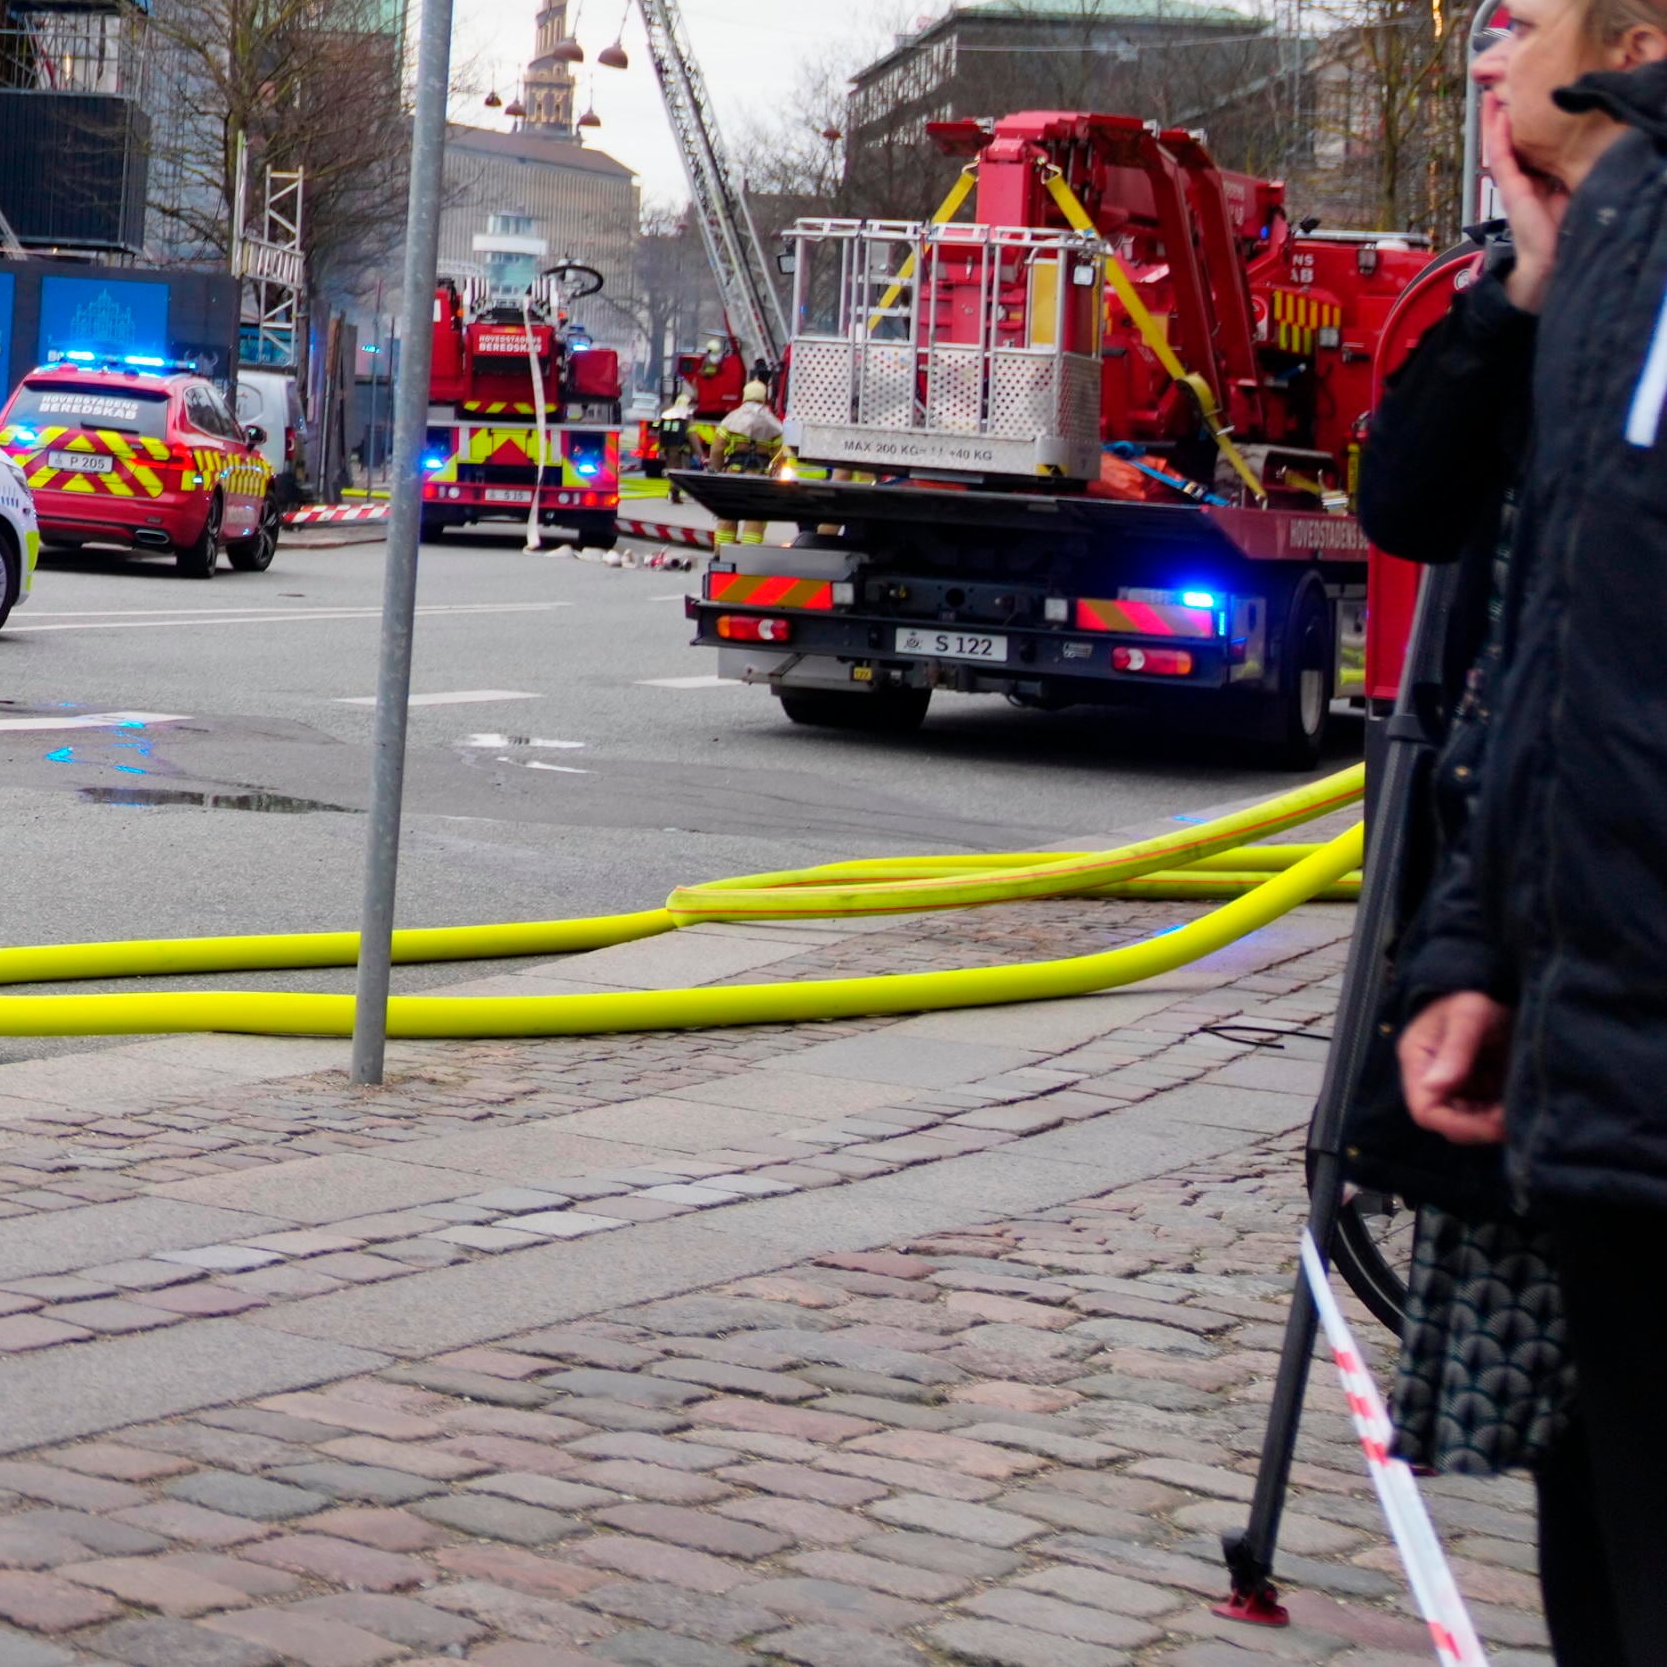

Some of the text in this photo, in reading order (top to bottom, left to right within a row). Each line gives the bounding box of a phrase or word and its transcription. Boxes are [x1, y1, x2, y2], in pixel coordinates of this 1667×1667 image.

[38, 402, 138, 421] BEREDSKAB
[42, 394, 140, 412] HOVEDSTADENS
[844, 440, 872, 452] MAX
[875, 442, 898, 455] 200
[973, 449, 993, 462] KG
[69, 454, 106, 469] P 205
[935, 634, 994, 657] S 122
